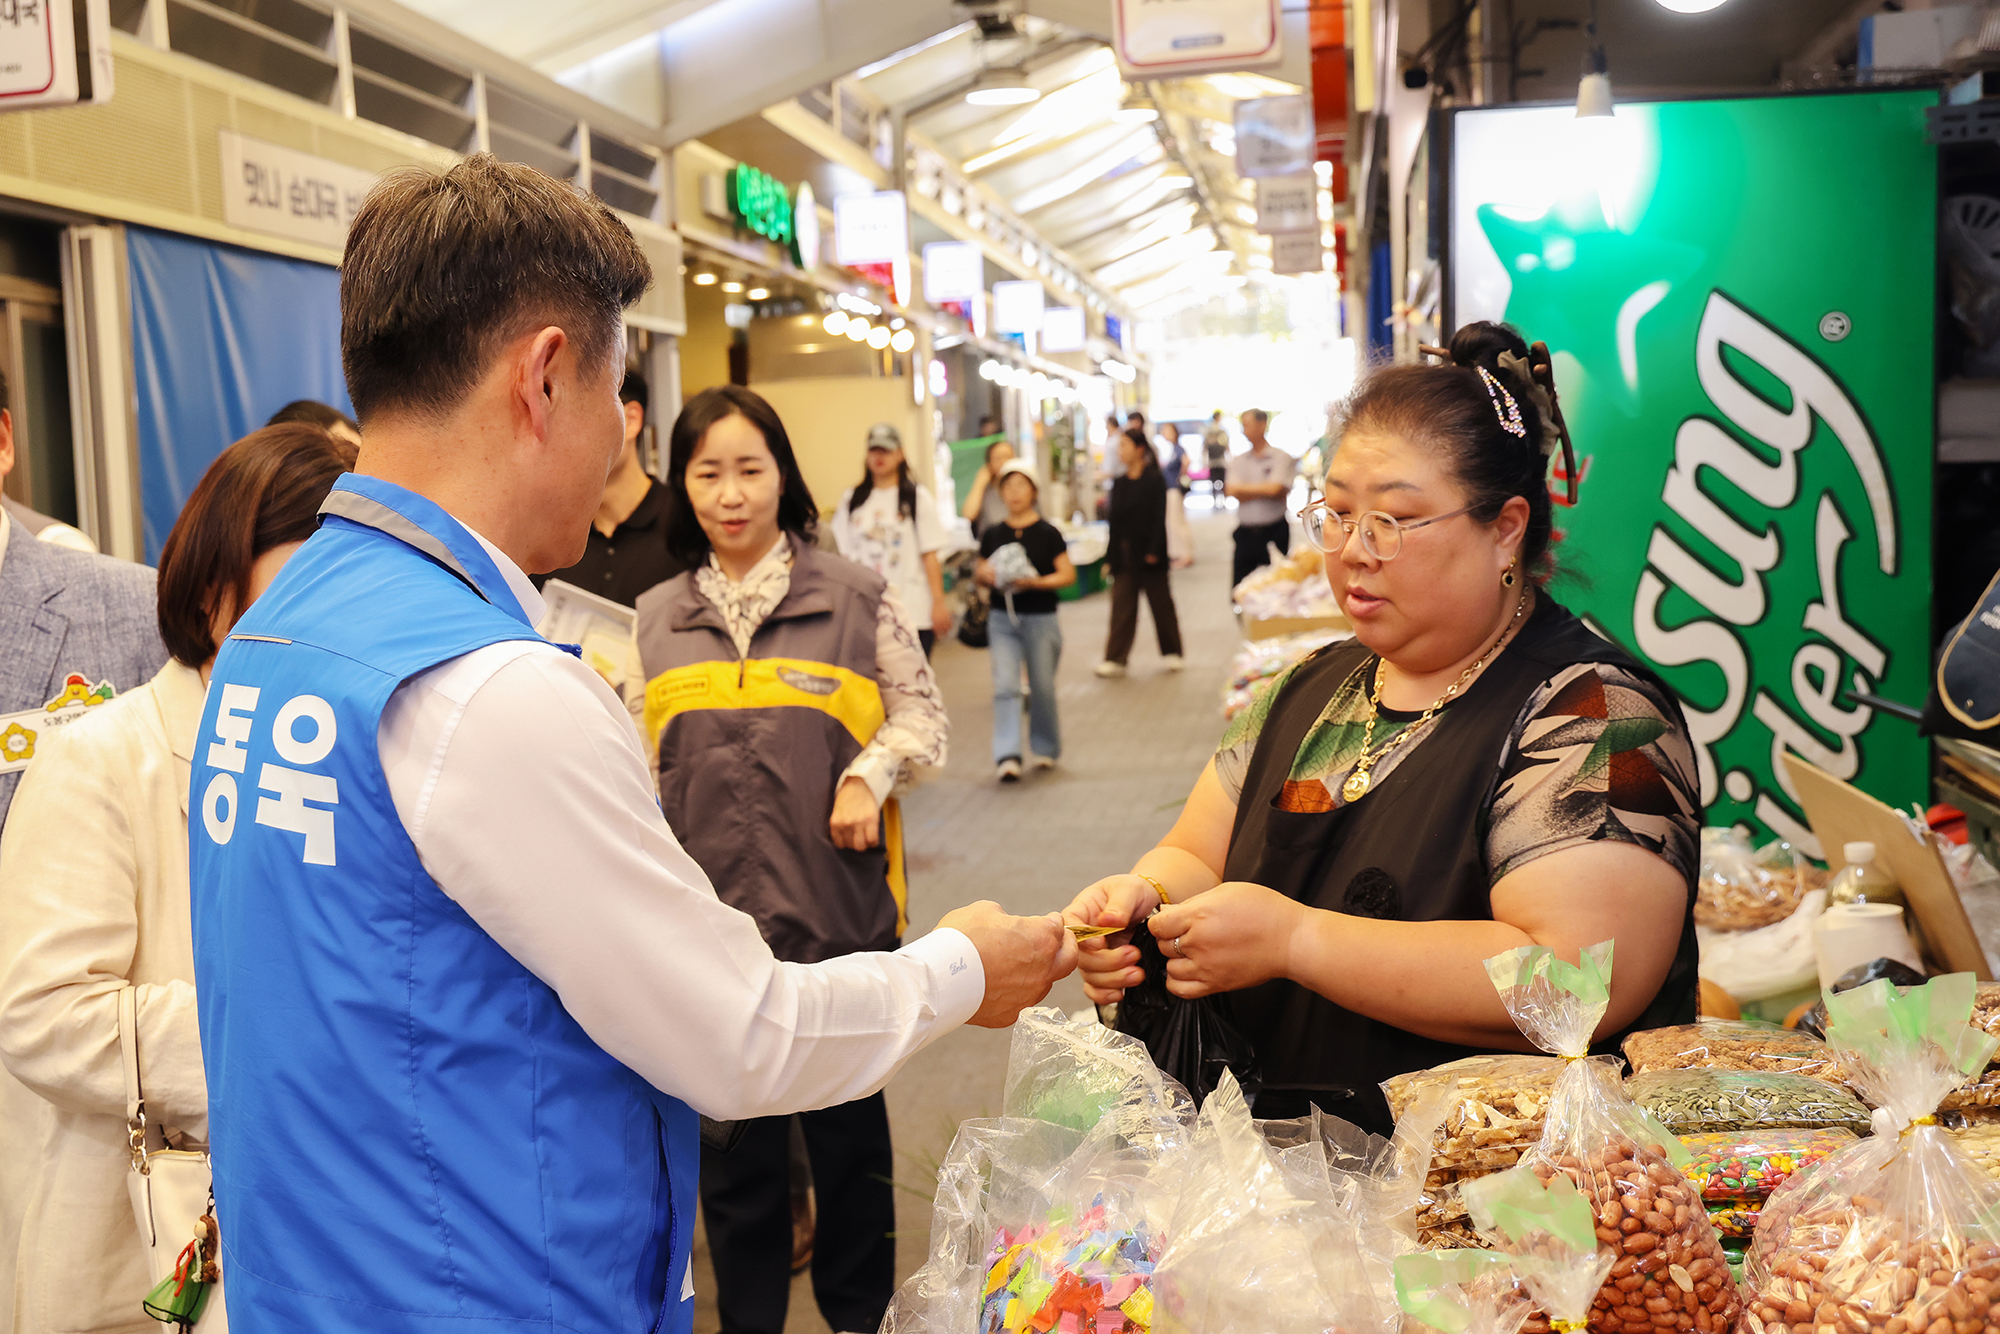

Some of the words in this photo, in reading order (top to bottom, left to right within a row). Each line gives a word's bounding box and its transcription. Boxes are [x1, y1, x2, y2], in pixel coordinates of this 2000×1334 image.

[43, 709, 89, 727] 도봉구의
[1724, 487, 1894, 866] ider
[192, 680, 340, 866] 동욱
